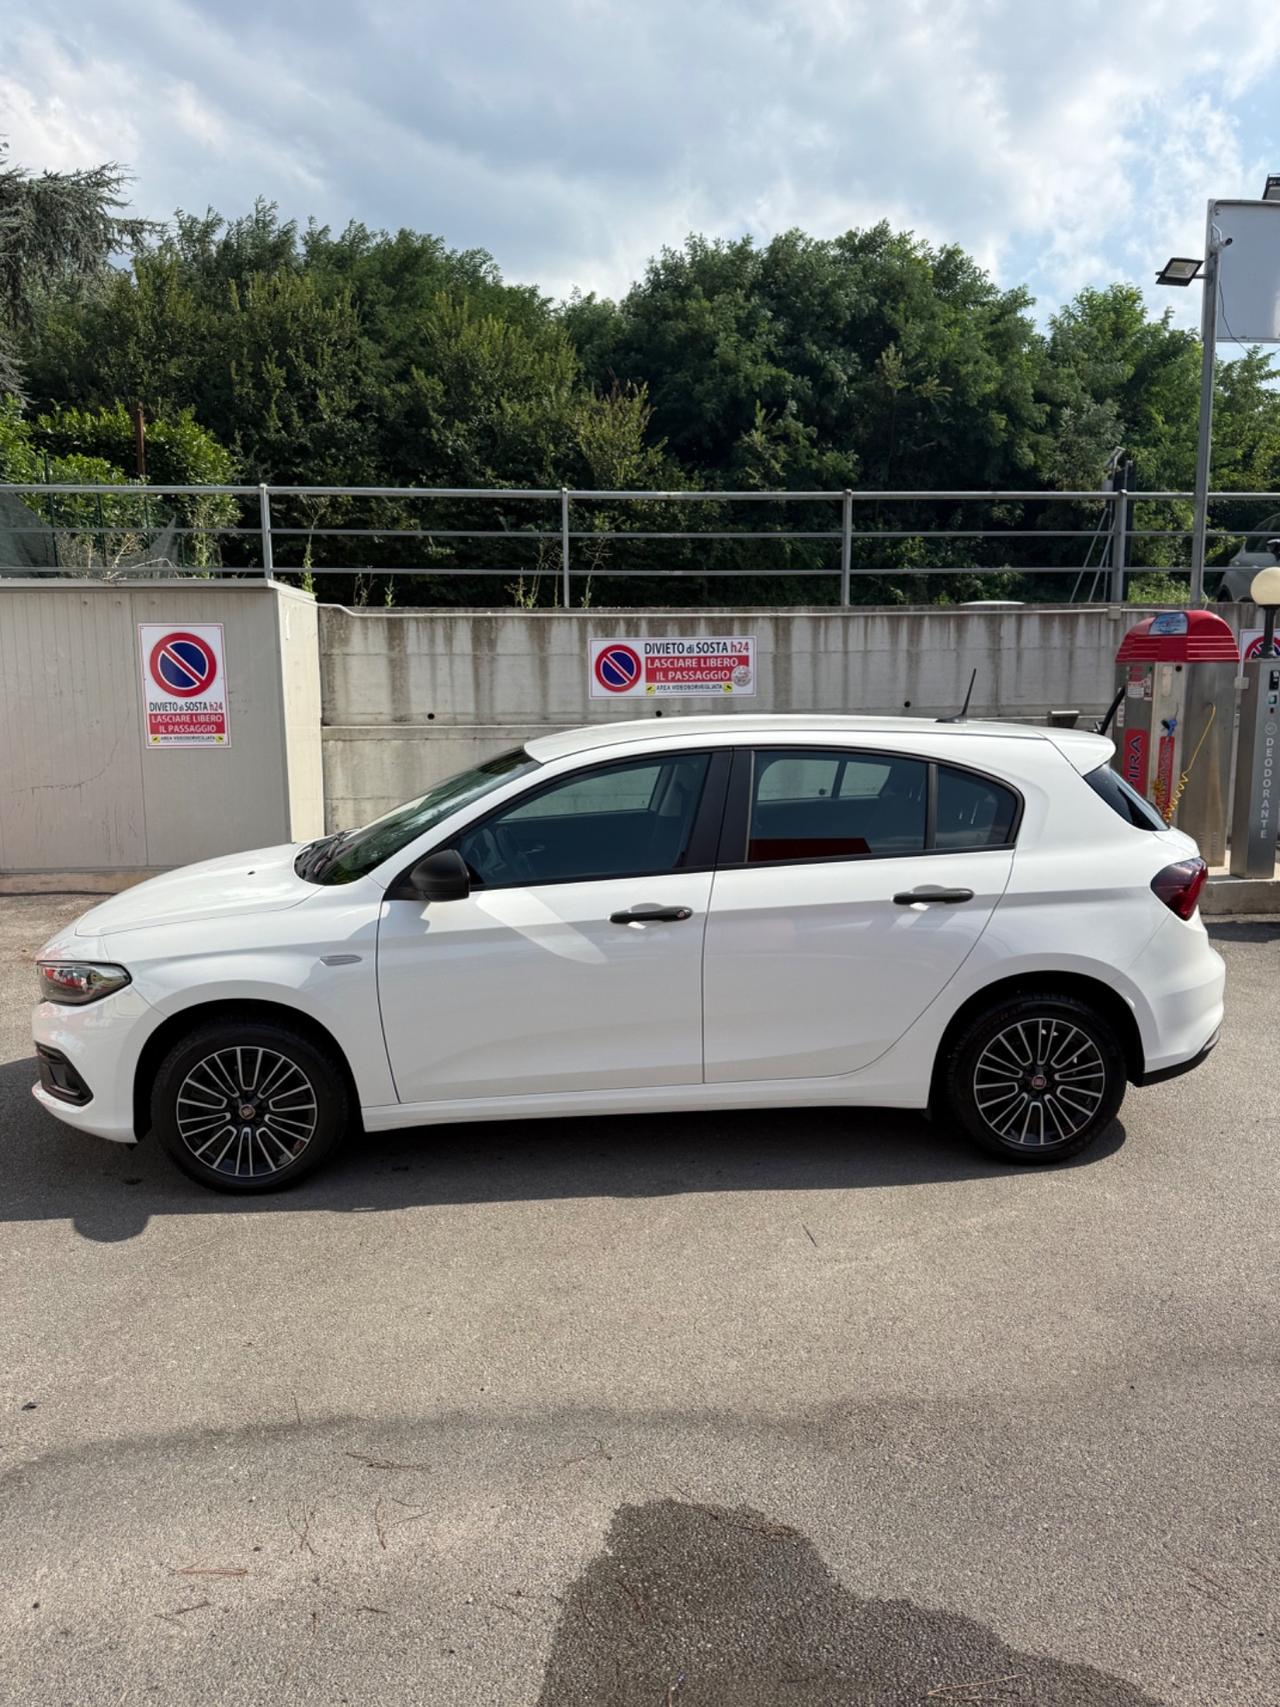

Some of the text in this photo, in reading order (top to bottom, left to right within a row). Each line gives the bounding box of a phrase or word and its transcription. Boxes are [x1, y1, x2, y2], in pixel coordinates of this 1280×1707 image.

[644, 642, 749, 654] DIVIETO di SOSTA h24
[647, 658, 738, 668] LASCIARE LIBERO
[656, 672, 666, 681] IL
[668, 671, 730, 680] PASSAGGIO
[149, 702, 177, 711] DIVIETO
[184, 702, 208, 711] SOSTA
[209, 702, 223, 711] h24
[151, 715, 223, 723] LASCIARE LIBERO
[159, 725, 217, 733] IL PASSAGGIO
[1260, 738, 1274, 839] DEODORANTE
